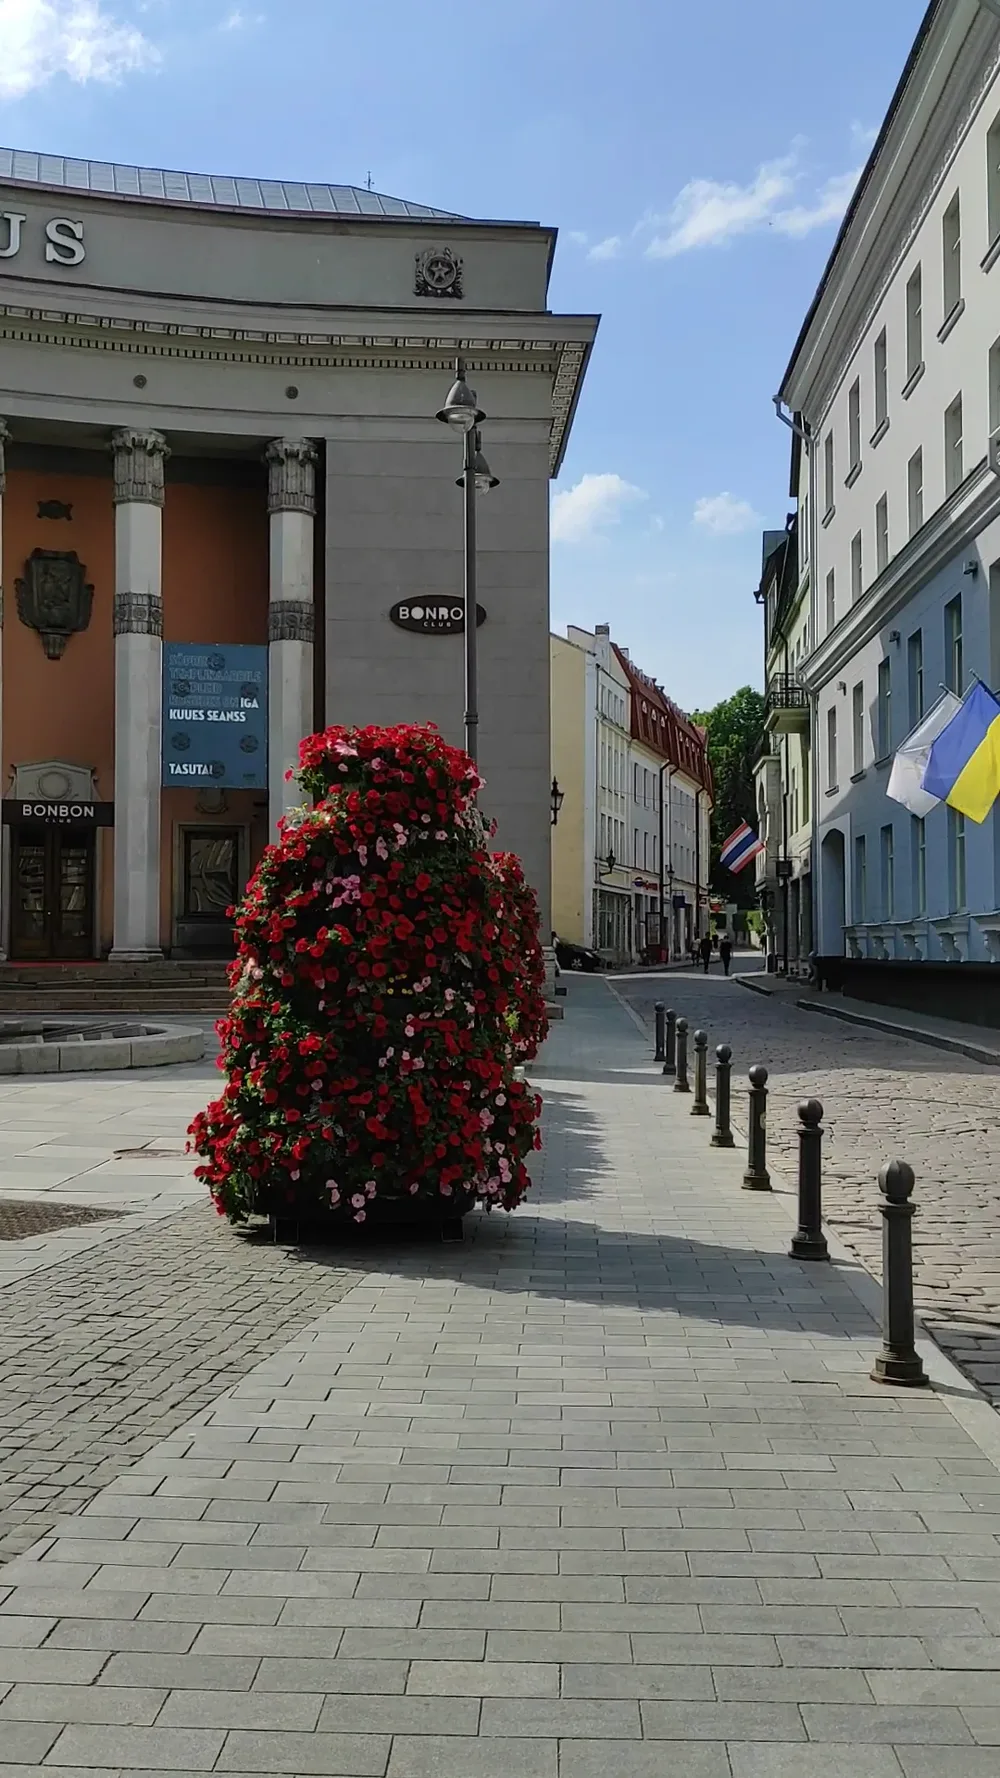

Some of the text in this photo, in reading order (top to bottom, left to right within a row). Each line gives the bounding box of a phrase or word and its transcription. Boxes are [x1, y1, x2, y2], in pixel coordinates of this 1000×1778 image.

[399, 606, 464, 621] BONBO
[240, 697, 259, 709] IGA
[169, 709, 246, 722] KUUES SEANSS
[22, 804, 94, 818] BONBON
